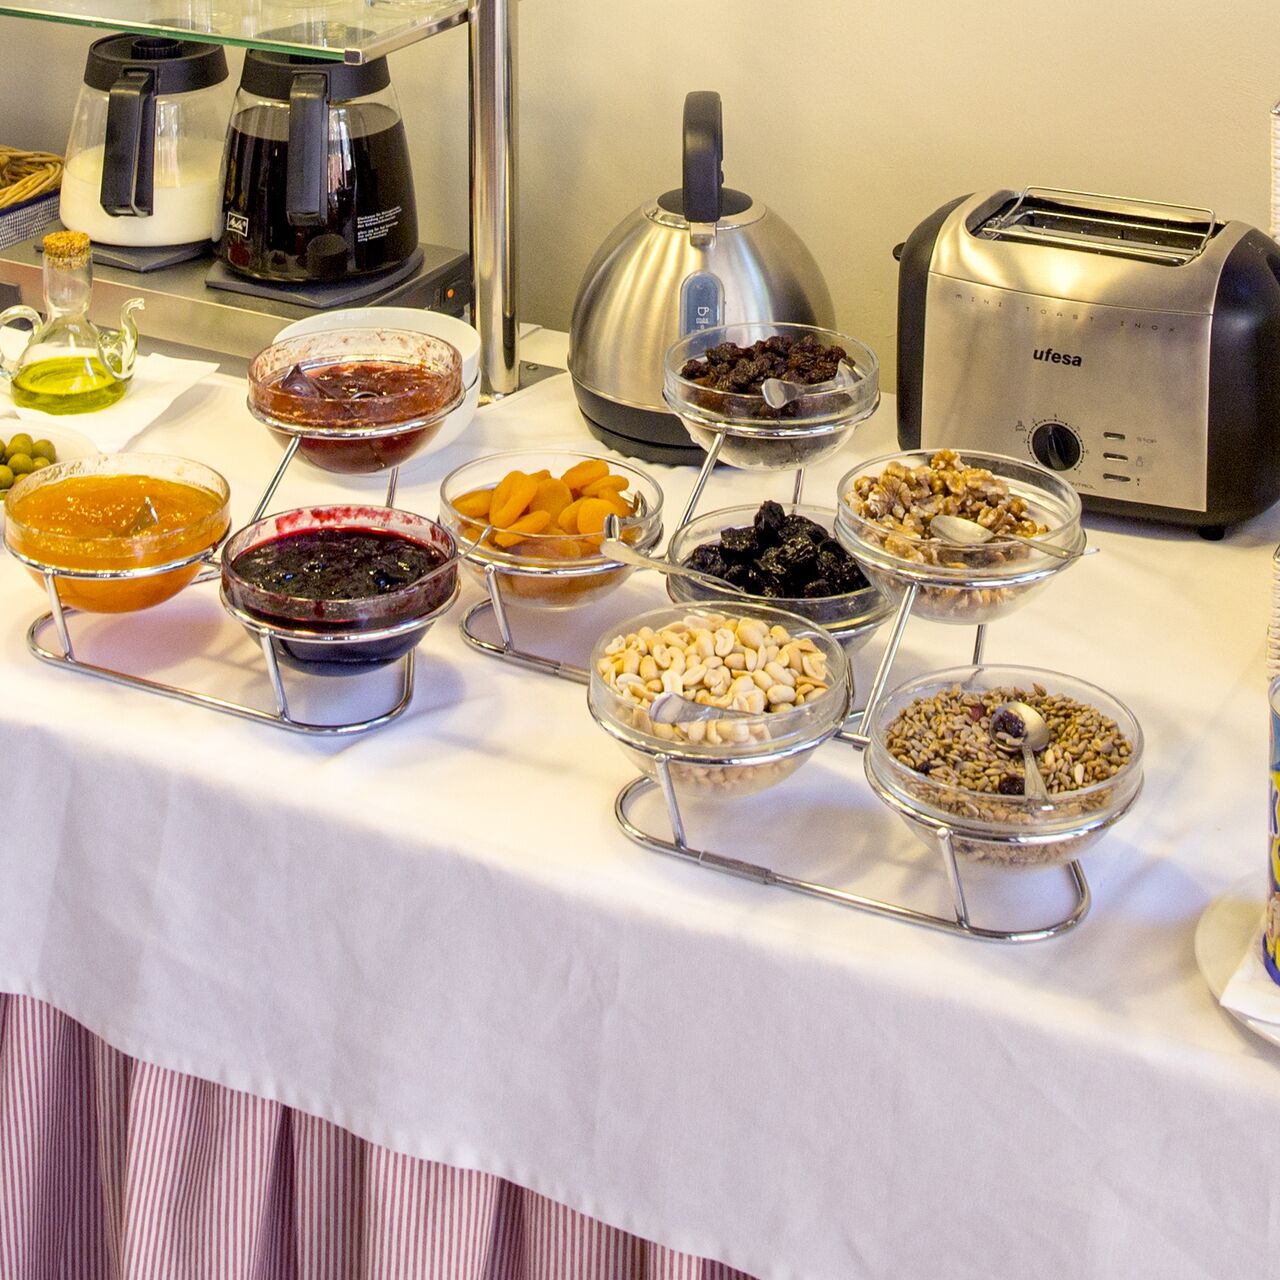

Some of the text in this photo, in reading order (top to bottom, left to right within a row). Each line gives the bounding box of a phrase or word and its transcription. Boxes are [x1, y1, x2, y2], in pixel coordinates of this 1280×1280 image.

[955, 293, 1175, 332] MINI TOAST INOX
[1032, 347, 1082, 367] ufesa
